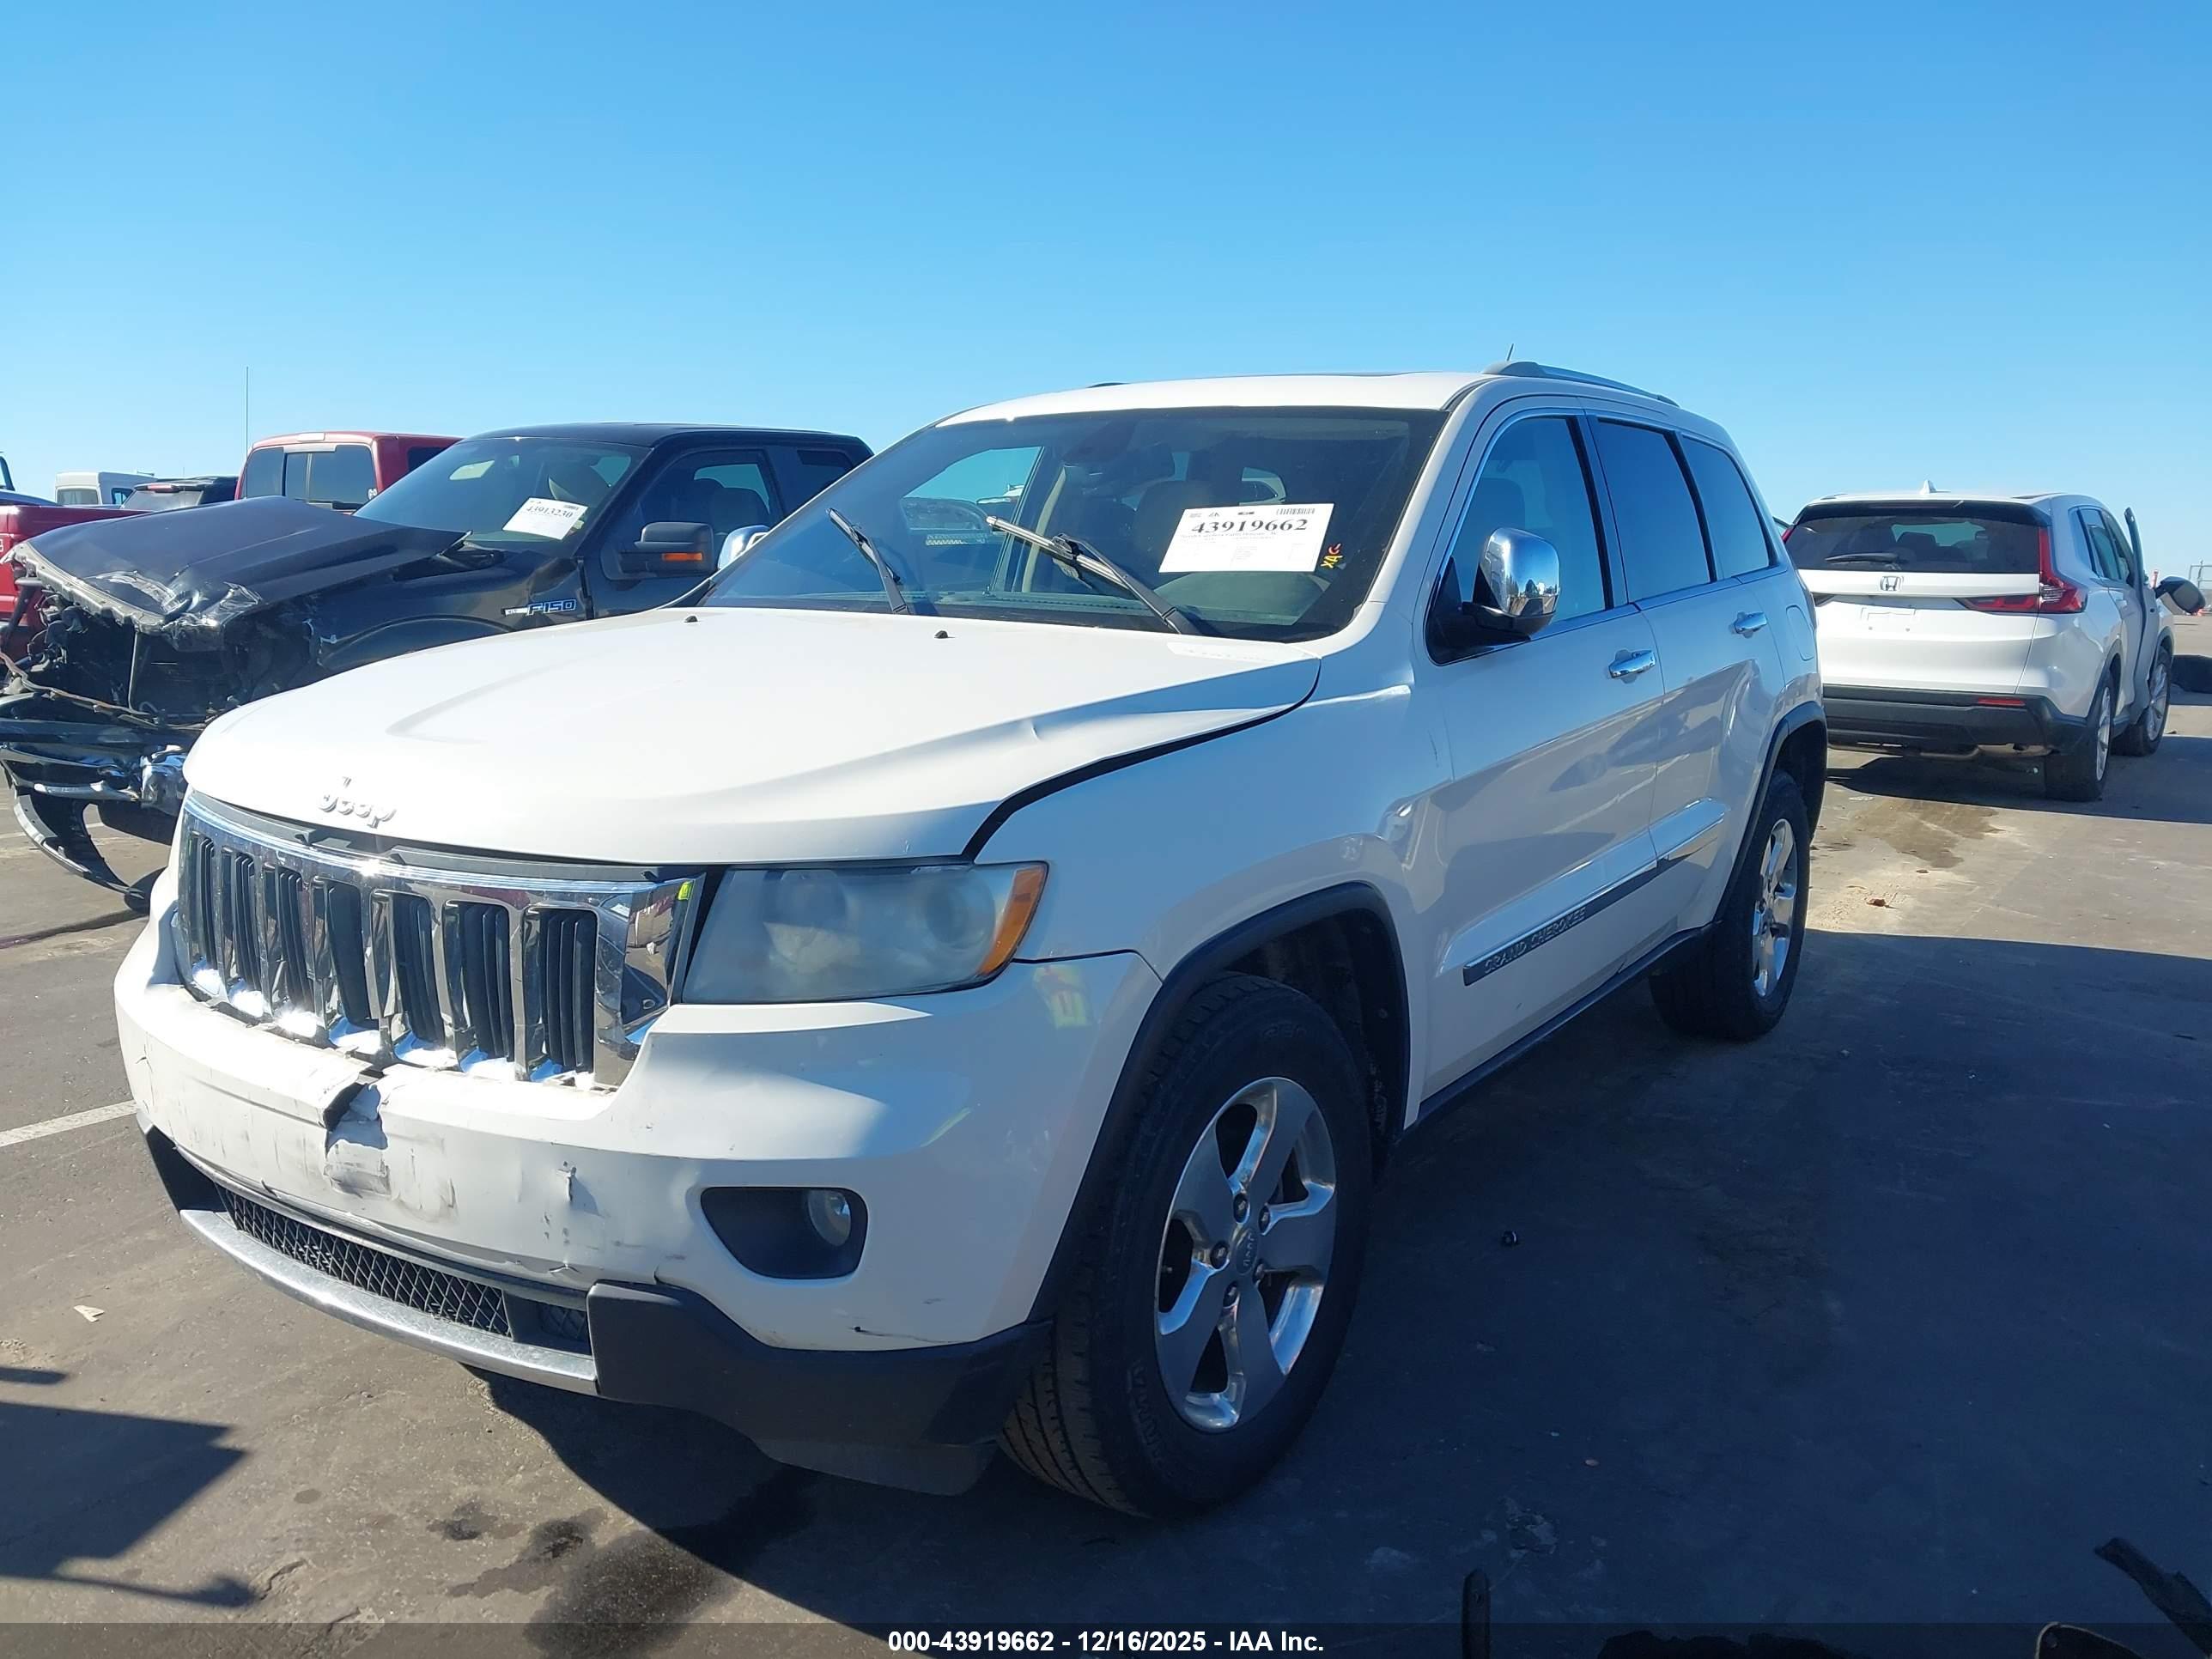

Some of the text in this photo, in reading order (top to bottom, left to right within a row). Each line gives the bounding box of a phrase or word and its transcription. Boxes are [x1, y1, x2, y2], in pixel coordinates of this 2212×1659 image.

[1191, 519, 1309, 533] 43919662
[317, 776, 397, 829] Jeep
[1530, 906, 1586, 947] CHEROKEE
